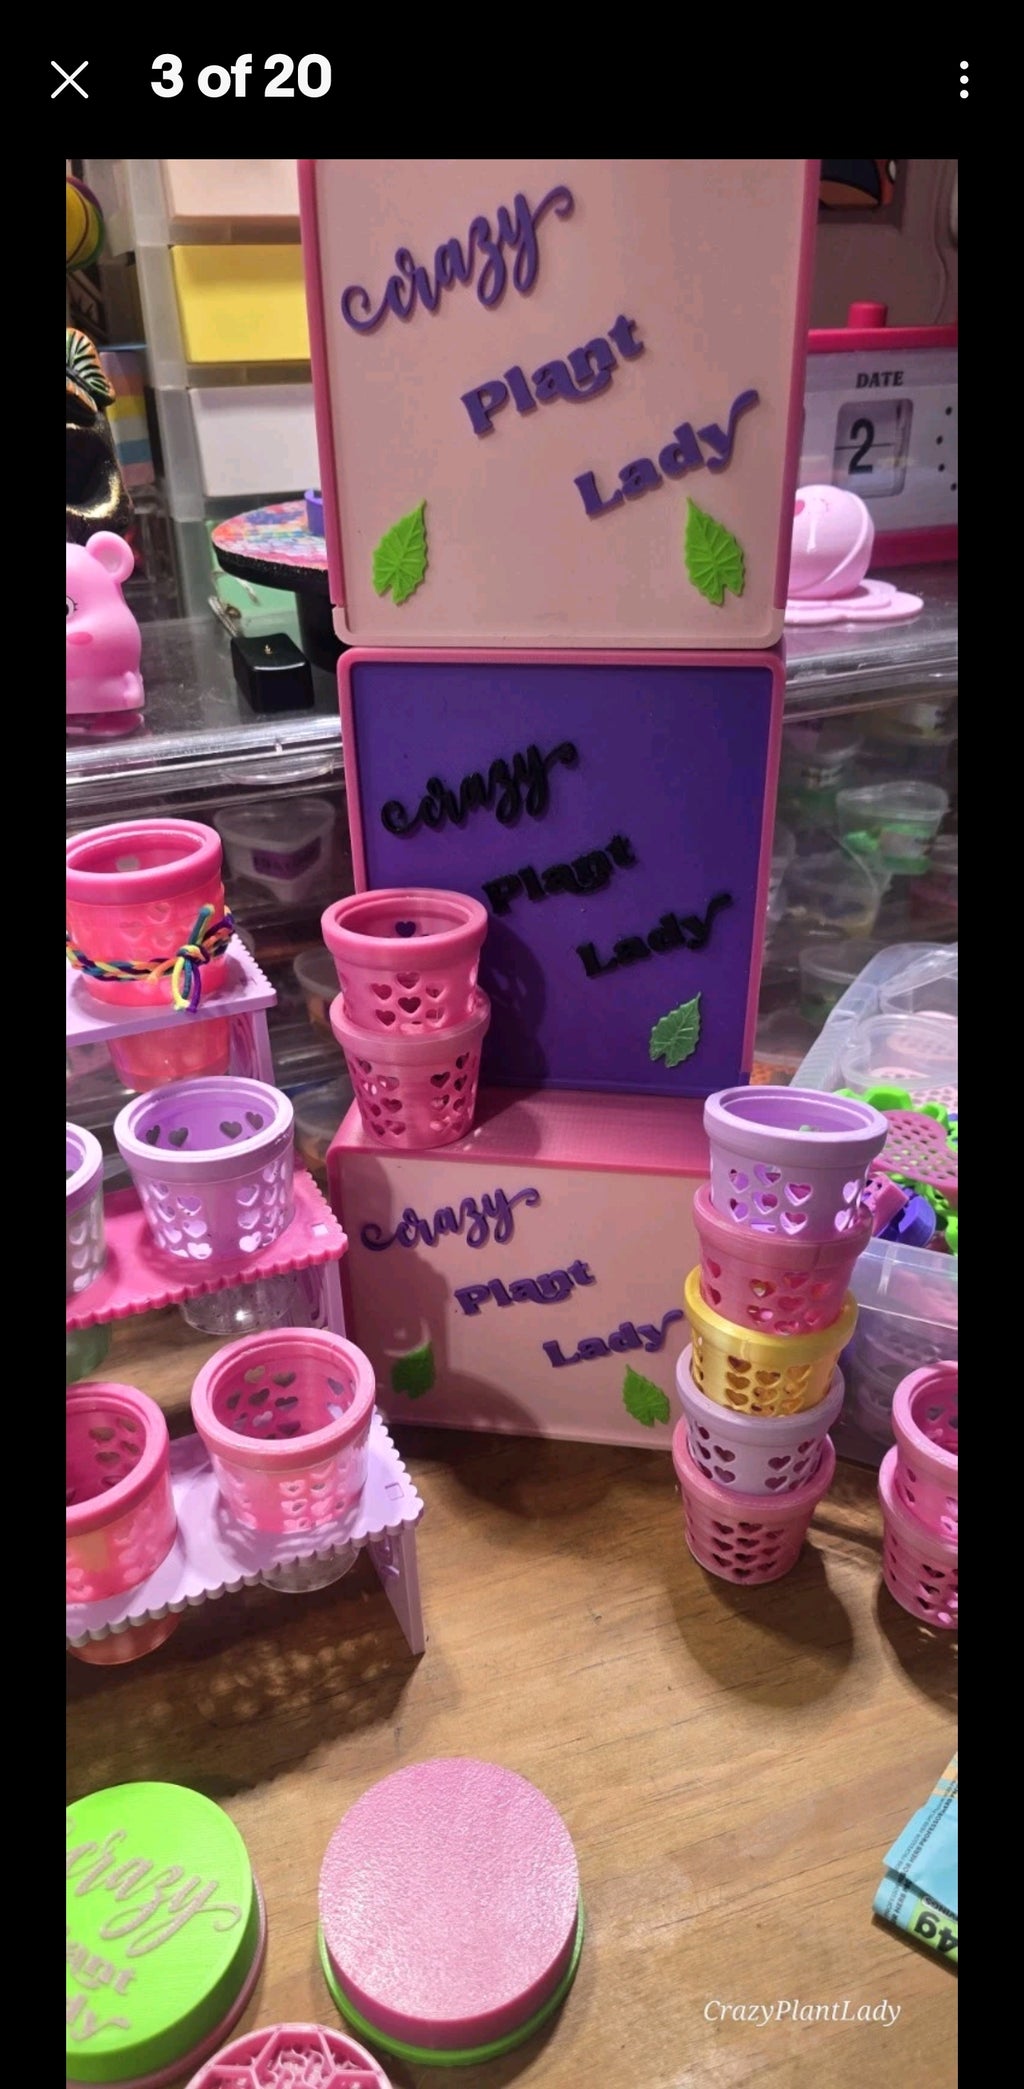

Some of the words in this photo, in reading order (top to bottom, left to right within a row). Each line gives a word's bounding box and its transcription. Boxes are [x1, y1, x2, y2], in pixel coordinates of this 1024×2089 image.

[460, 314, 644, 437] Plant
[856, 371, 904, 388] DATE
[574, 389, 760, 518] Lady
[848, 418, 874, 475] 2
[482, 834, 637, 914] Plant
[576, 893, 733, 978] Lady
[454, 1259, 596, 1315] Plant
[542, 1309, 684, 1367] Lady
